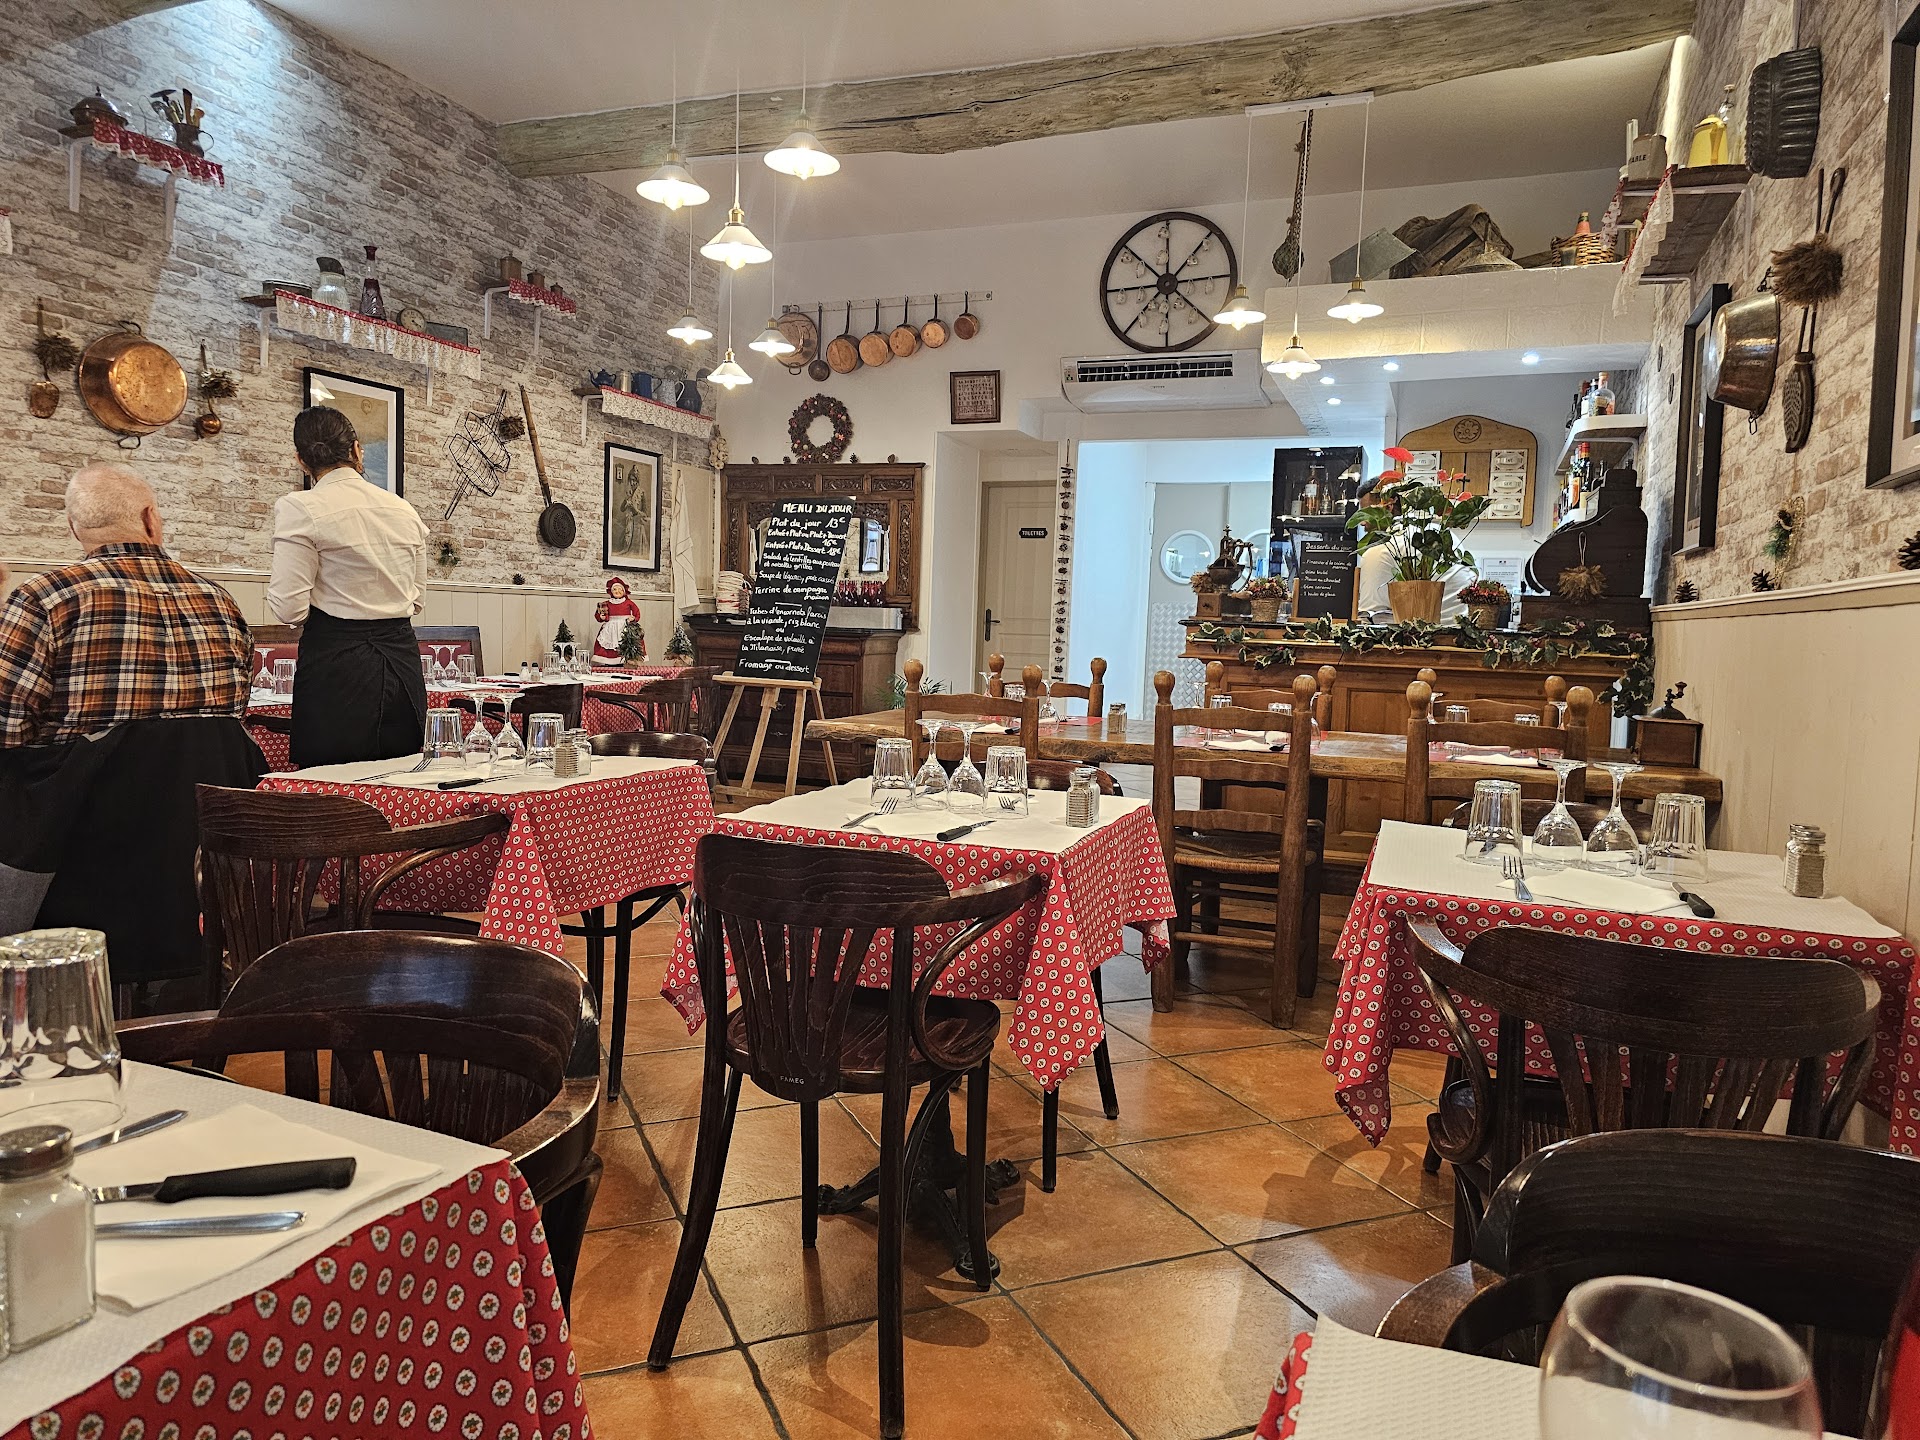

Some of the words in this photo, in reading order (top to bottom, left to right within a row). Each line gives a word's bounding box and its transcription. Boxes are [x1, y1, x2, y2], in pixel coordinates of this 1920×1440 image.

[782, 503, 813, 514] MENU
[816, 504, 828, 513] DU
[828, 504, 853, 514] JOUR
[772, 517, 789, 526] Plat
[790, 519, 801, 528] du
[801, 519, 822, 530] jour
[755, 586, 780, 594] Terrine
[782, 584, 792, 593] de
[750, 607, 768, 615] Tubes
[753, 616, 760, 624] la
[800, 618, 820, 628] blanc
[739, 658, 772, 672] Fromage
[785, 662, 809, 674] dessert
[780, 1076, 804, 1084] FAMEG
